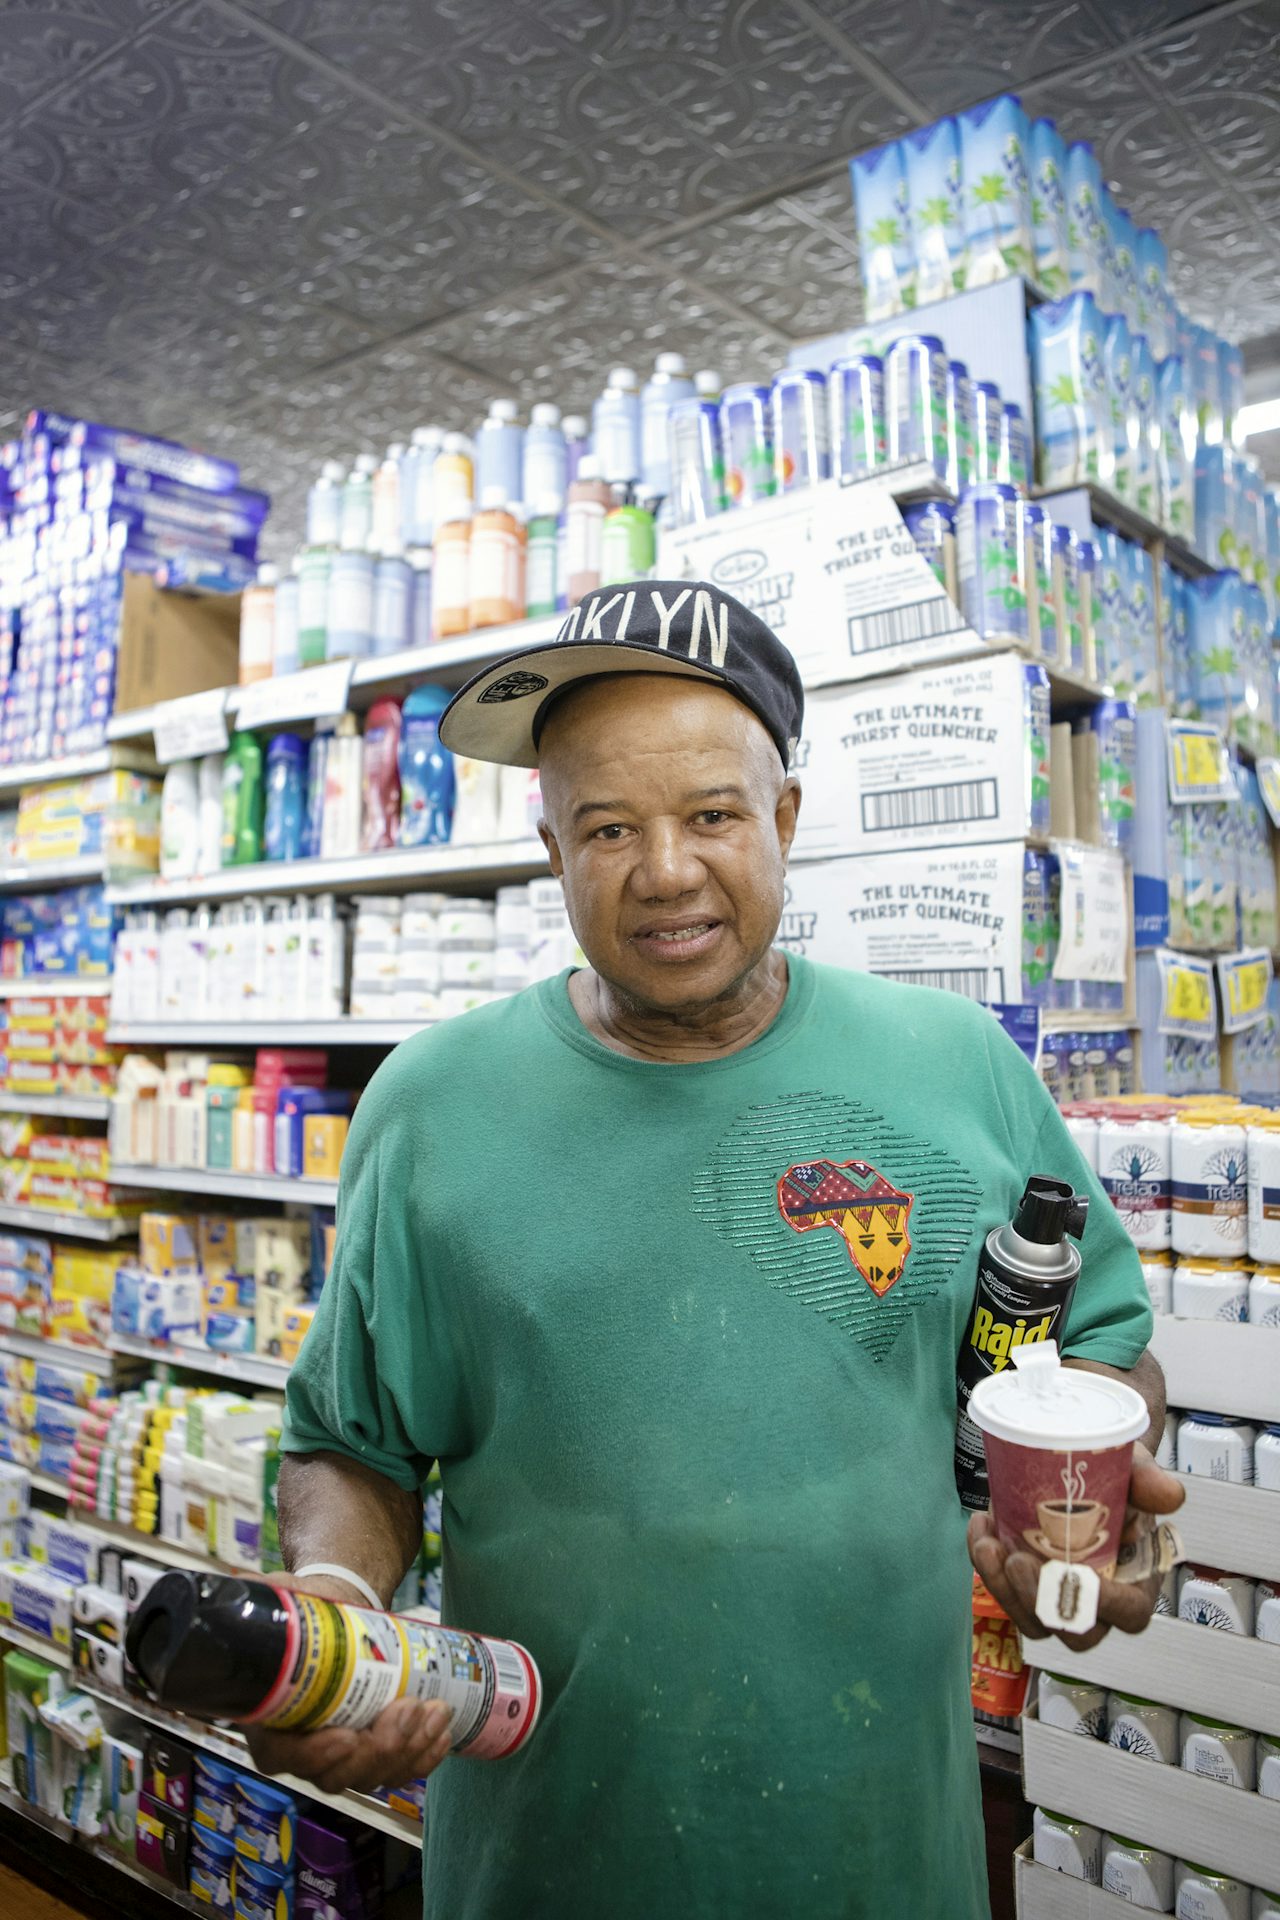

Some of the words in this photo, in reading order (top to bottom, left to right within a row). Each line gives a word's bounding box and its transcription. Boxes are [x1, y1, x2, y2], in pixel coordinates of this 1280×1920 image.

[853, 705, 884, 727] THE
[891, 703, 984, 723] ULTIMATE
[840, 723, 900, 749] THIRST
[908, 723, 999, 745] QUENCHER
[862, 885, 894, 904] THE
[898, 884, 991, 908] ULTIMATE
[848, 903, 907, 926] THIRST
[916, 903, 1005, 931] QUENCHER
[1111, 1179, 1161, 1198] tretap
[970, 1306, 1051, 1358] Raid
[1195, 1746, 1224, 1765] tretap
[298, 1869, 339, 1899] always
